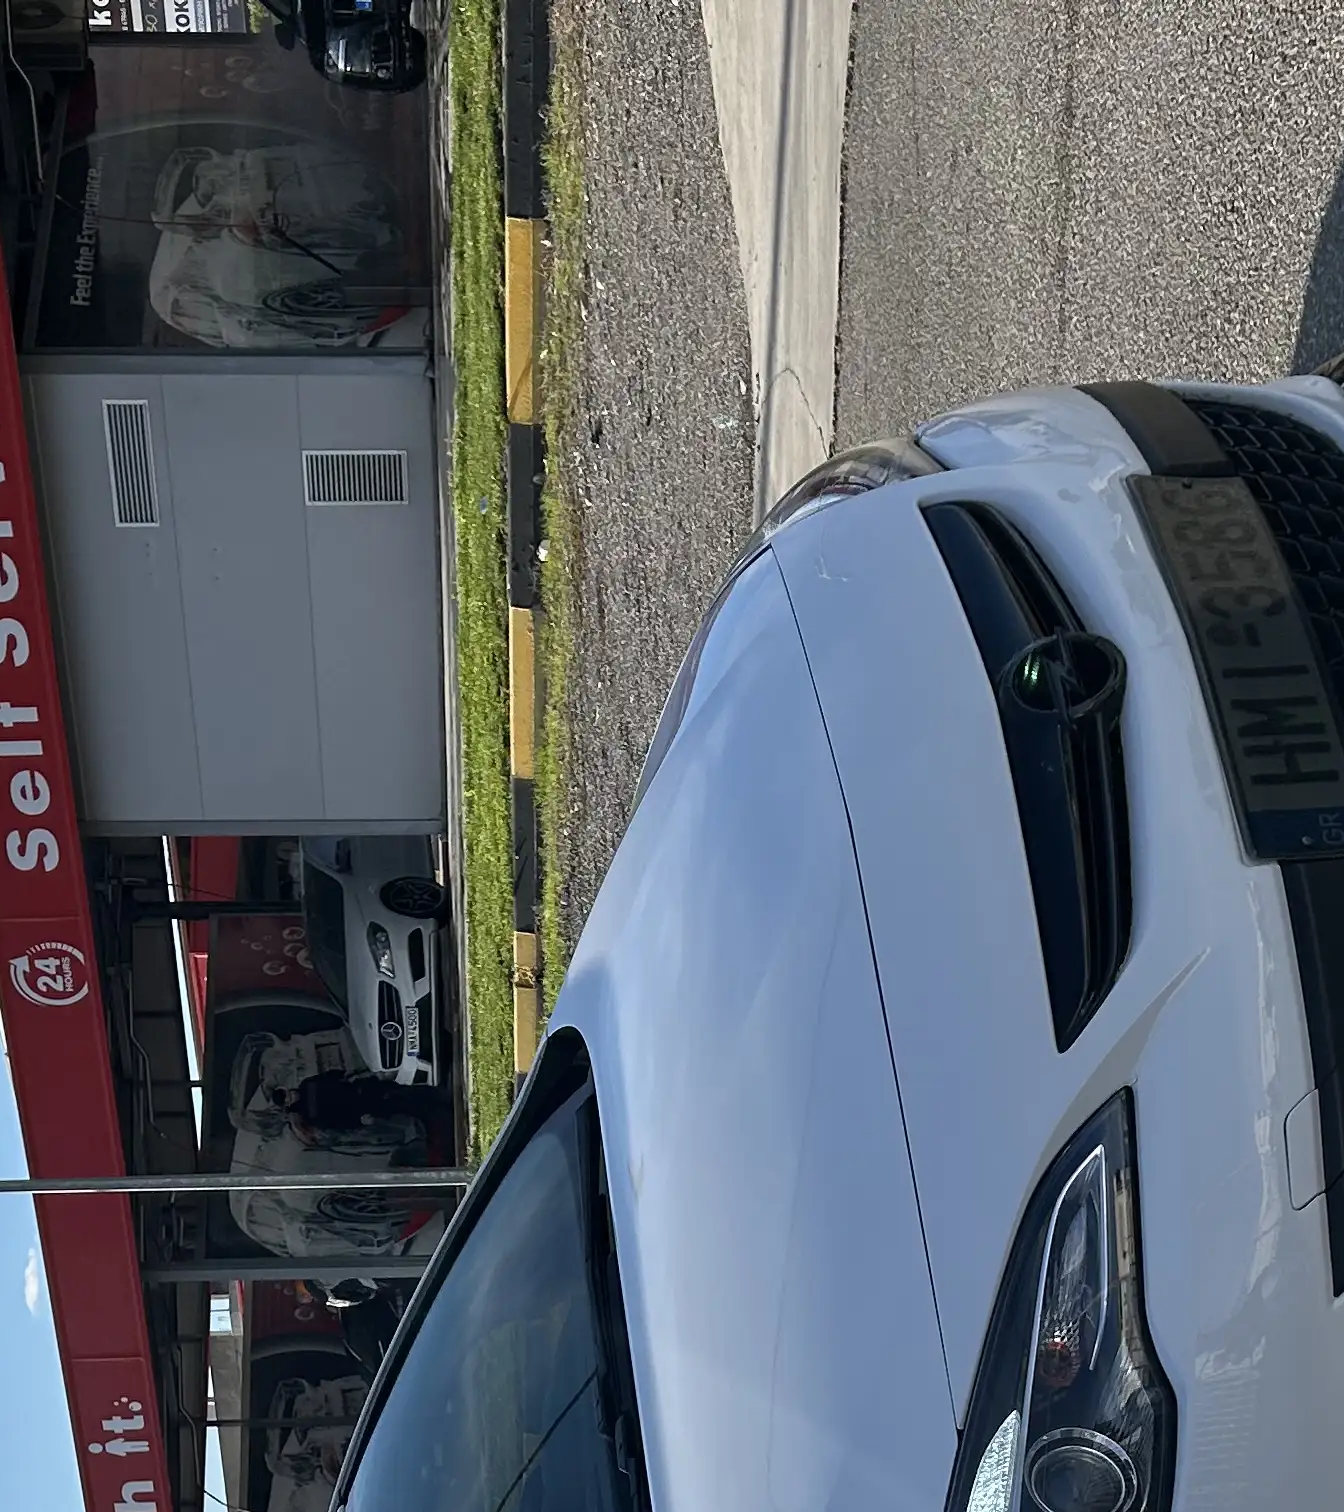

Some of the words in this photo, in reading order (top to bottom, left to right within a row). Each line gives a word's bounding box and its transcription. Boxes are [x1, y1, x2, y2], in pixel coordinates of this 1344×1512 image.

[74, 246, 95, 272] the
[69, 274, 92, 306] Feel
[34, 957, 64, 992] 24
[61, 956, 74, 992] HOURS
